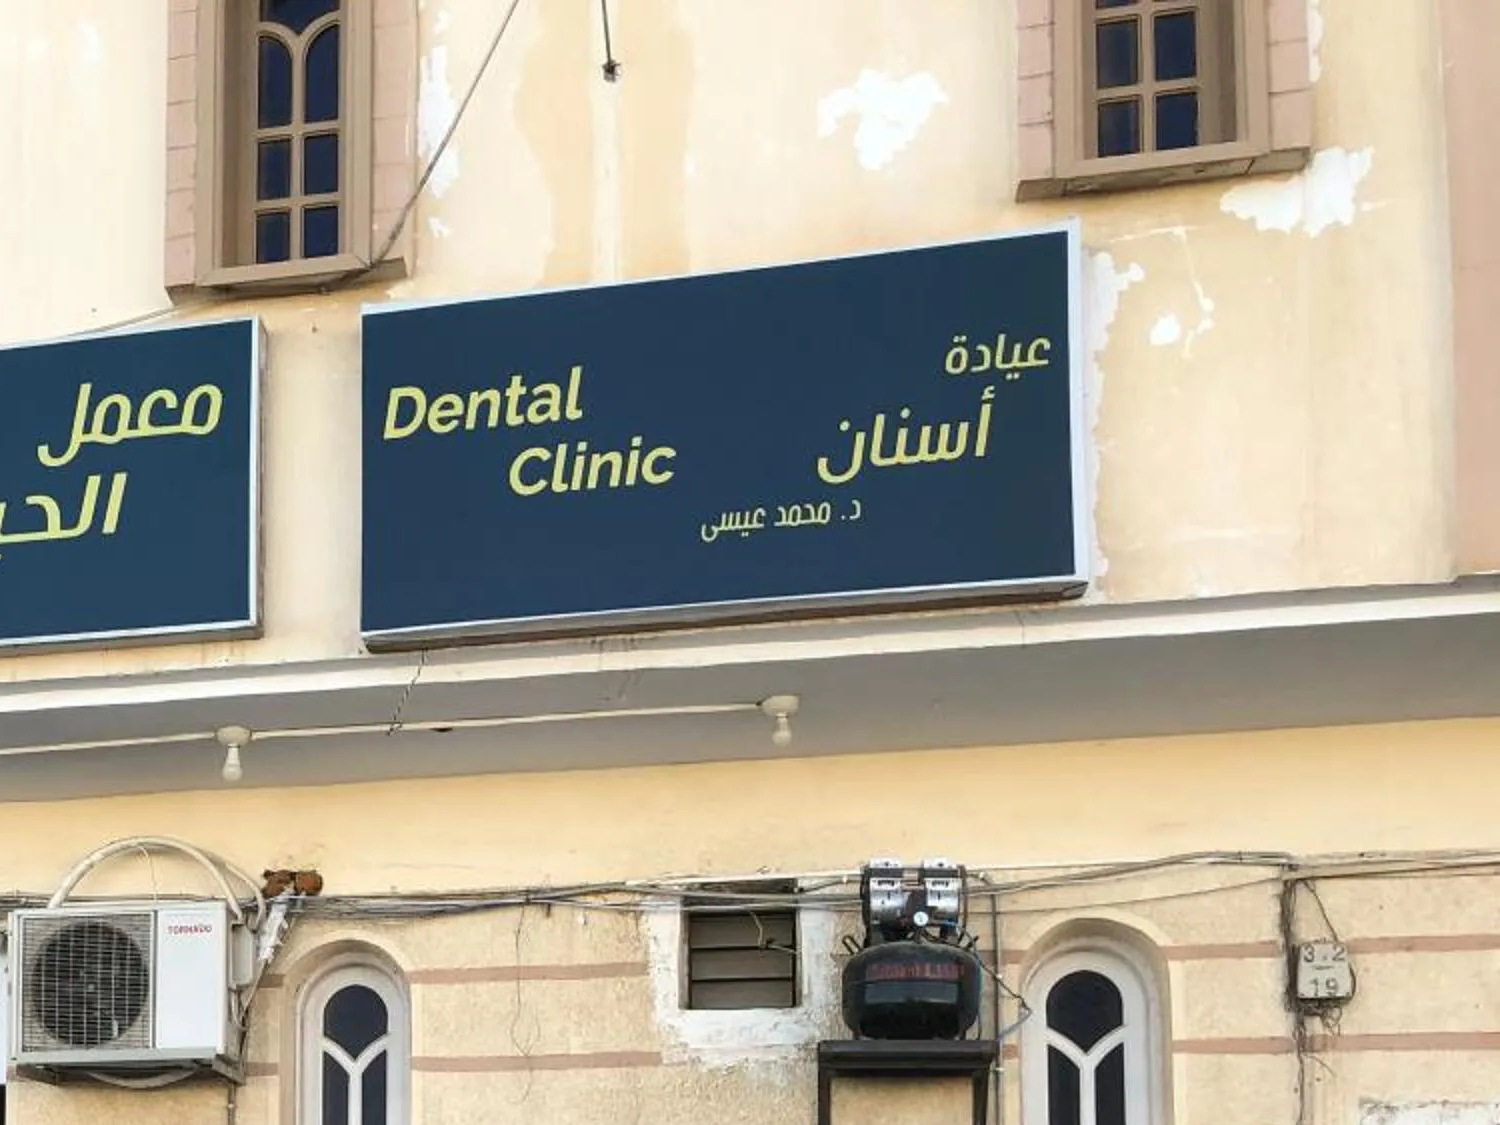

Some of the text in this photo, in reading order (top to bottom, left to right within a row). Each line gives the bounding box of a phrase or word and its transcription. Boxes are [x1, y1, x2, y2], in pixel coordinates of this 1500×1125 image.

[943, 332, 1052, 381] عيادة
[37, 382, 224, 467] معمل
[382, 366, 584, 441] Dental
[817, 385, 996, 485] أسنان
[508, 436, 677, 496] Clinic
[701, 507, 767, 542] عيسى
[773, 501, 831, 527] محمد
